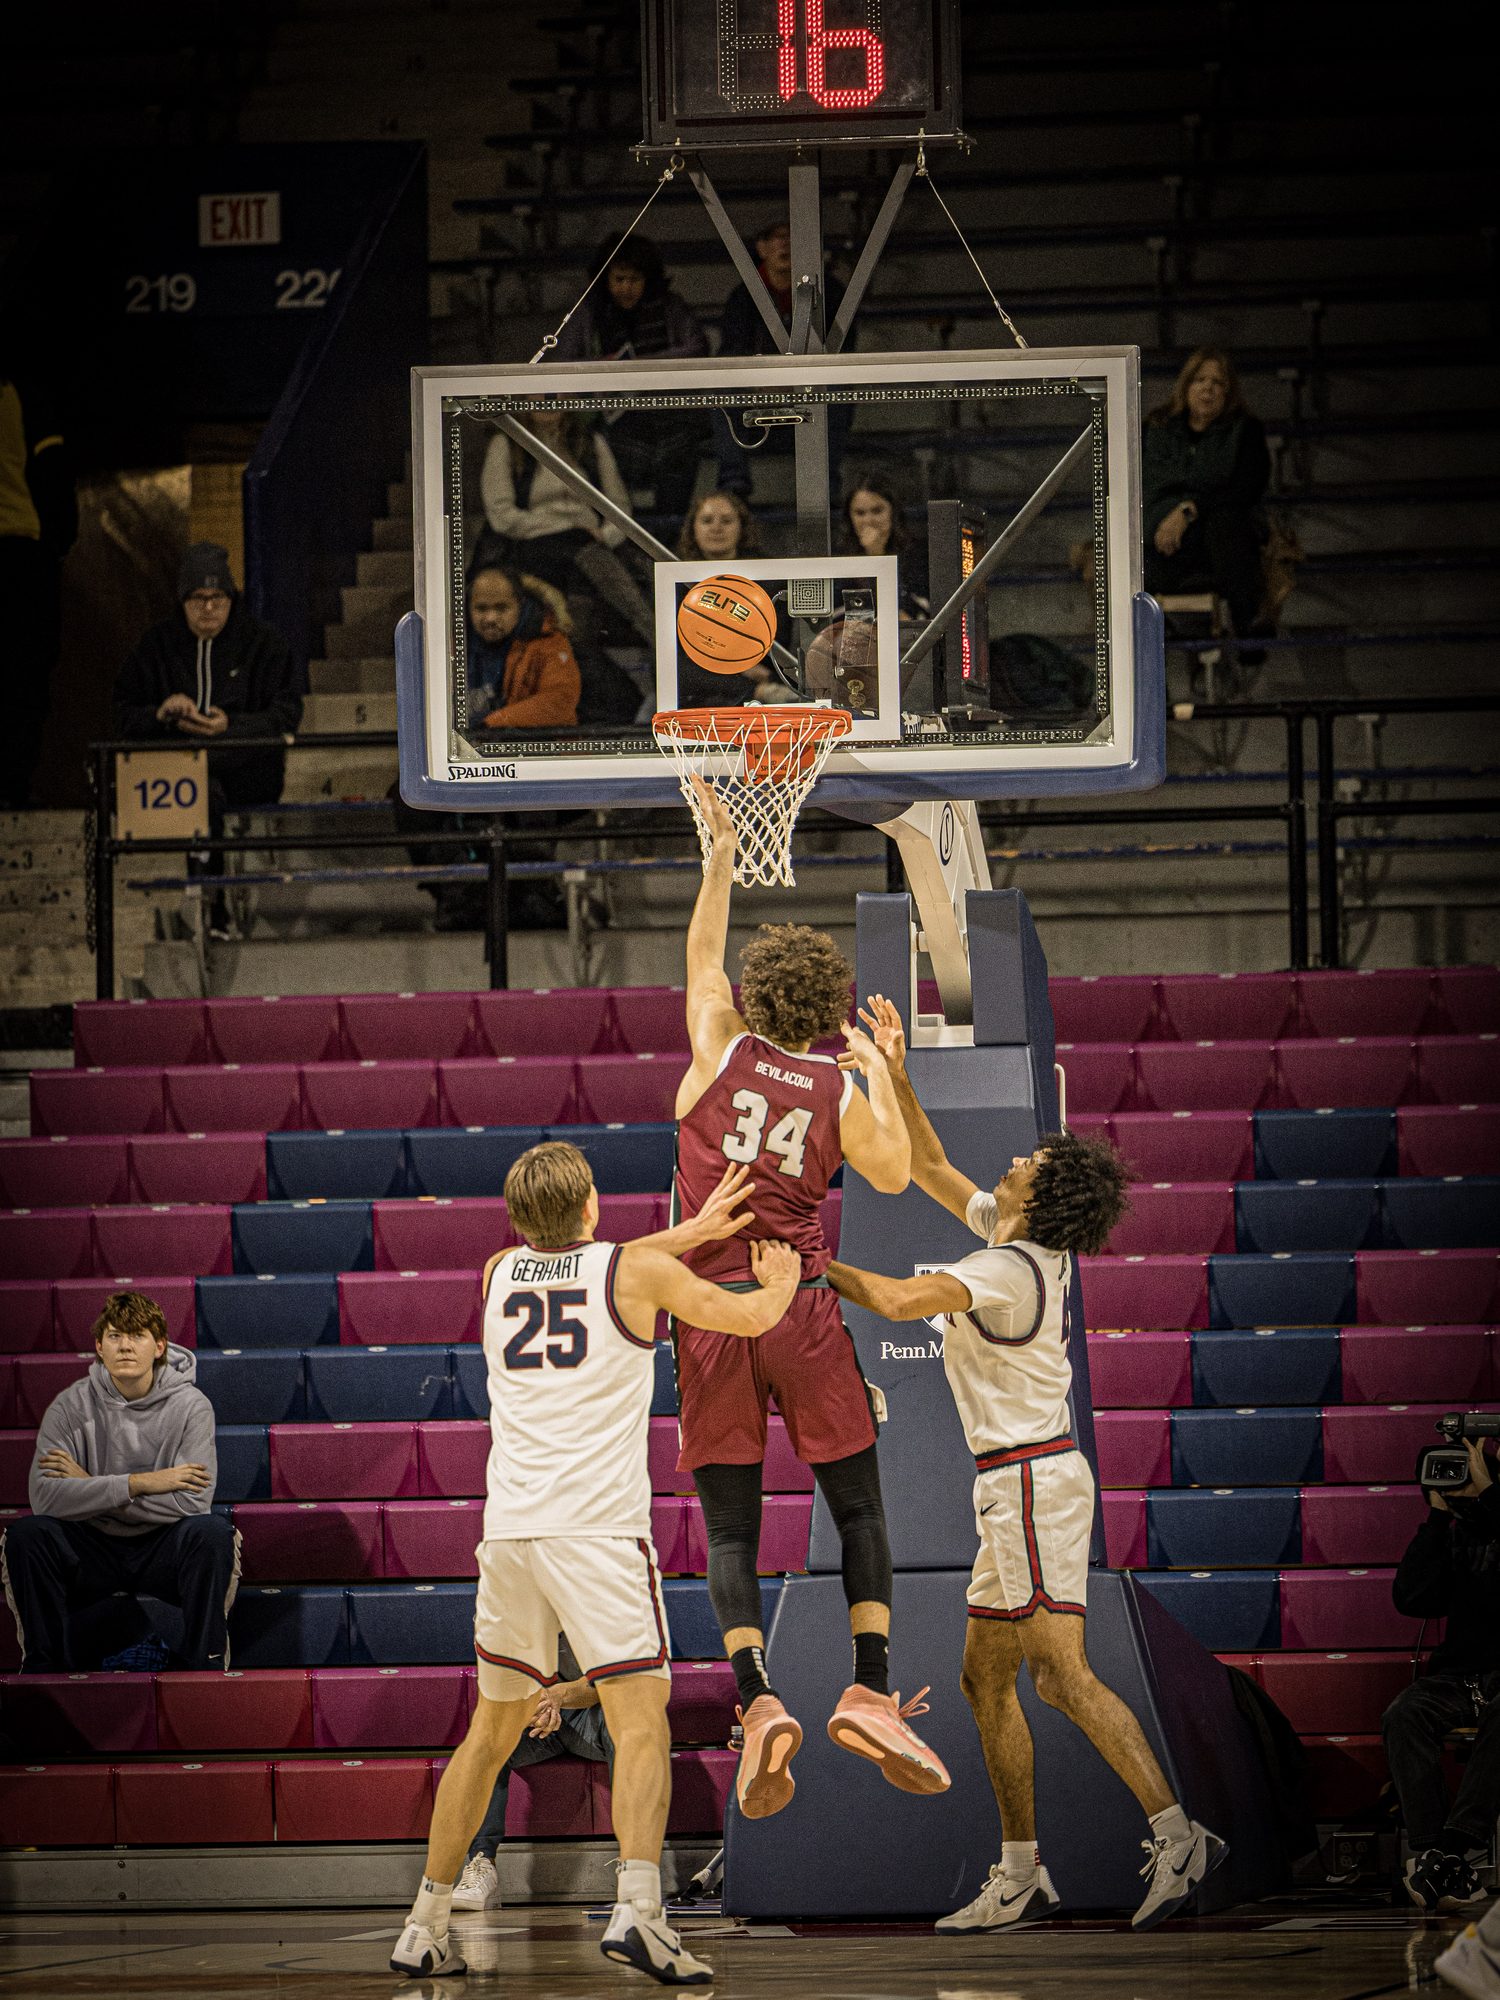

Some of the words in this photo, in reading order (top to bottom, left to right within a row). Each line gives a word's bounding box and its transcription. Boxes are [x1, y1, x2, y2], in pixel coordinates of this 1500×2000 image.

[778, 0, 885, 108] 16
[209, 198, 268, 242] EXIT
[126, 273, 197, 313] 219
[700, 590, 751, 622] ELITE
[448, 763, 516, 781] SPALDING
[134, 778, 198, 810] 120
[754, 1061, 814, 1091] BEVILACQUA
[721, 1088, 814, 1178] 34
[511, 1253, 583, 1282] GERHART
[503, 1289, 588, 1370] 25
[880, 1341, 927, 1360] Penn
